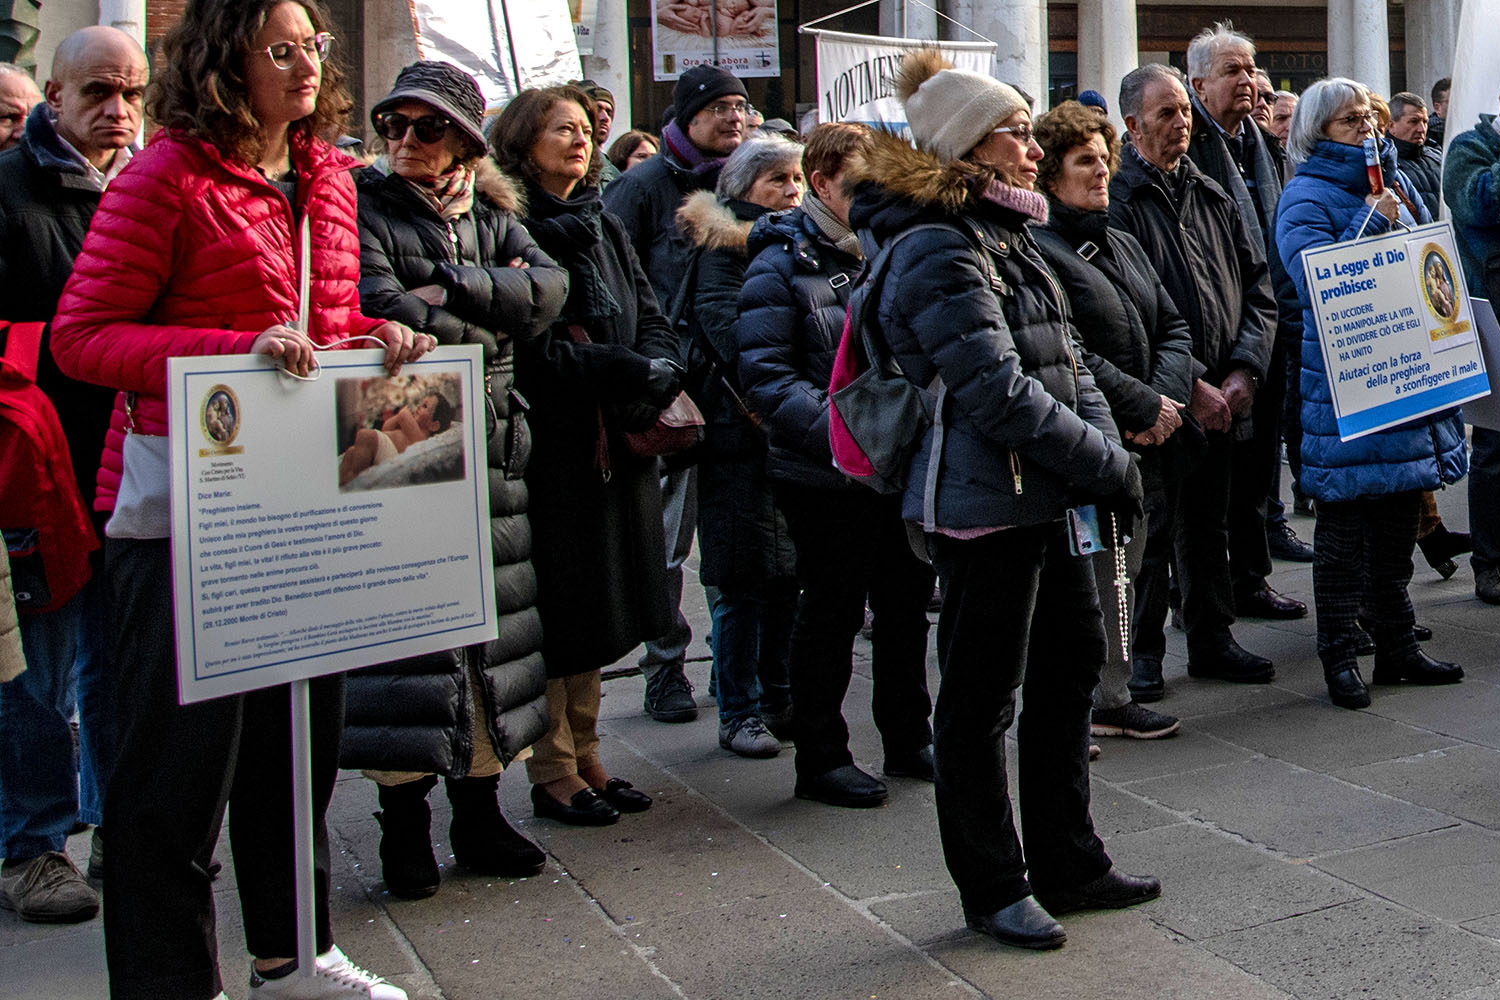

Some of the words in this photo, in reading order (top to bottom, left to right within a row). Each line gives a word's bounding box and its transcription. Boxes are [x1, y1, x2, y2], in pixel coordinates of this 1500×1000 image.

[682, 57, 699, 66] Ora
[719, 57, 749, 65] abora
[1270, 53, 1324, 69] FOTO
[825, 54, 904, 123] MOVIMEN
[1316, 265, 1331, 281] La
[1334, 258, 1370, 277] Legge
[1373, 252, 1384, 267] di
[1387, 249, 1405, 265] Dio
[1320, 278, 1377, 304] proibisce:
[1331, 310, 1340, 321] DI
[1340, 303, 1374, 320] UCCIDERE
[1334, 325, 1343, 335] DI
[1344, 314, 1388, 333] MANIPOLARE
[1390, 311, 1398, 321] LA
[1398, 307, 1414, 319] VITA
[1337, 338, 1346, 349] DI
[1346, 330, 1378, 348] DIVIDERE
[1379, 325, 1392, 339] CIÒ
[1392, 323, 1405, 335] CHE
[1406, 319, 1421, 332] EGLI
[1338, 363, 1371, 383] Aiutaci
[1372, 360, 1388, 374] con
[1390, 356, 1398, 368] la
[1400, 351, 1422, 366] forza
[1339, 352, 1350, 362] HA
[1351, 346, 1373, 360] UNITO
[1366, 374, 1388, 389] della
[1390, 362, 1431, 384] preghiera
[1395, 386, 1401, 395] a
[1403, 371, 1451, 393] sconfiggere
[1452, 365, 1458, 377] il
[1459, 361, 1478, 376] male
[198, 492, 212, 500] Dice
[199, 522, 213, 531] Figli
[236, 517, 257, 525] mondo
[267, 513, 291, 523] bisogno
[300, 507, 336, 519] purificazione
[247, 528, 277, 538] preghiera
[304, 521, 331, 531] preghiera
[339, 517, 358, 527] questo
